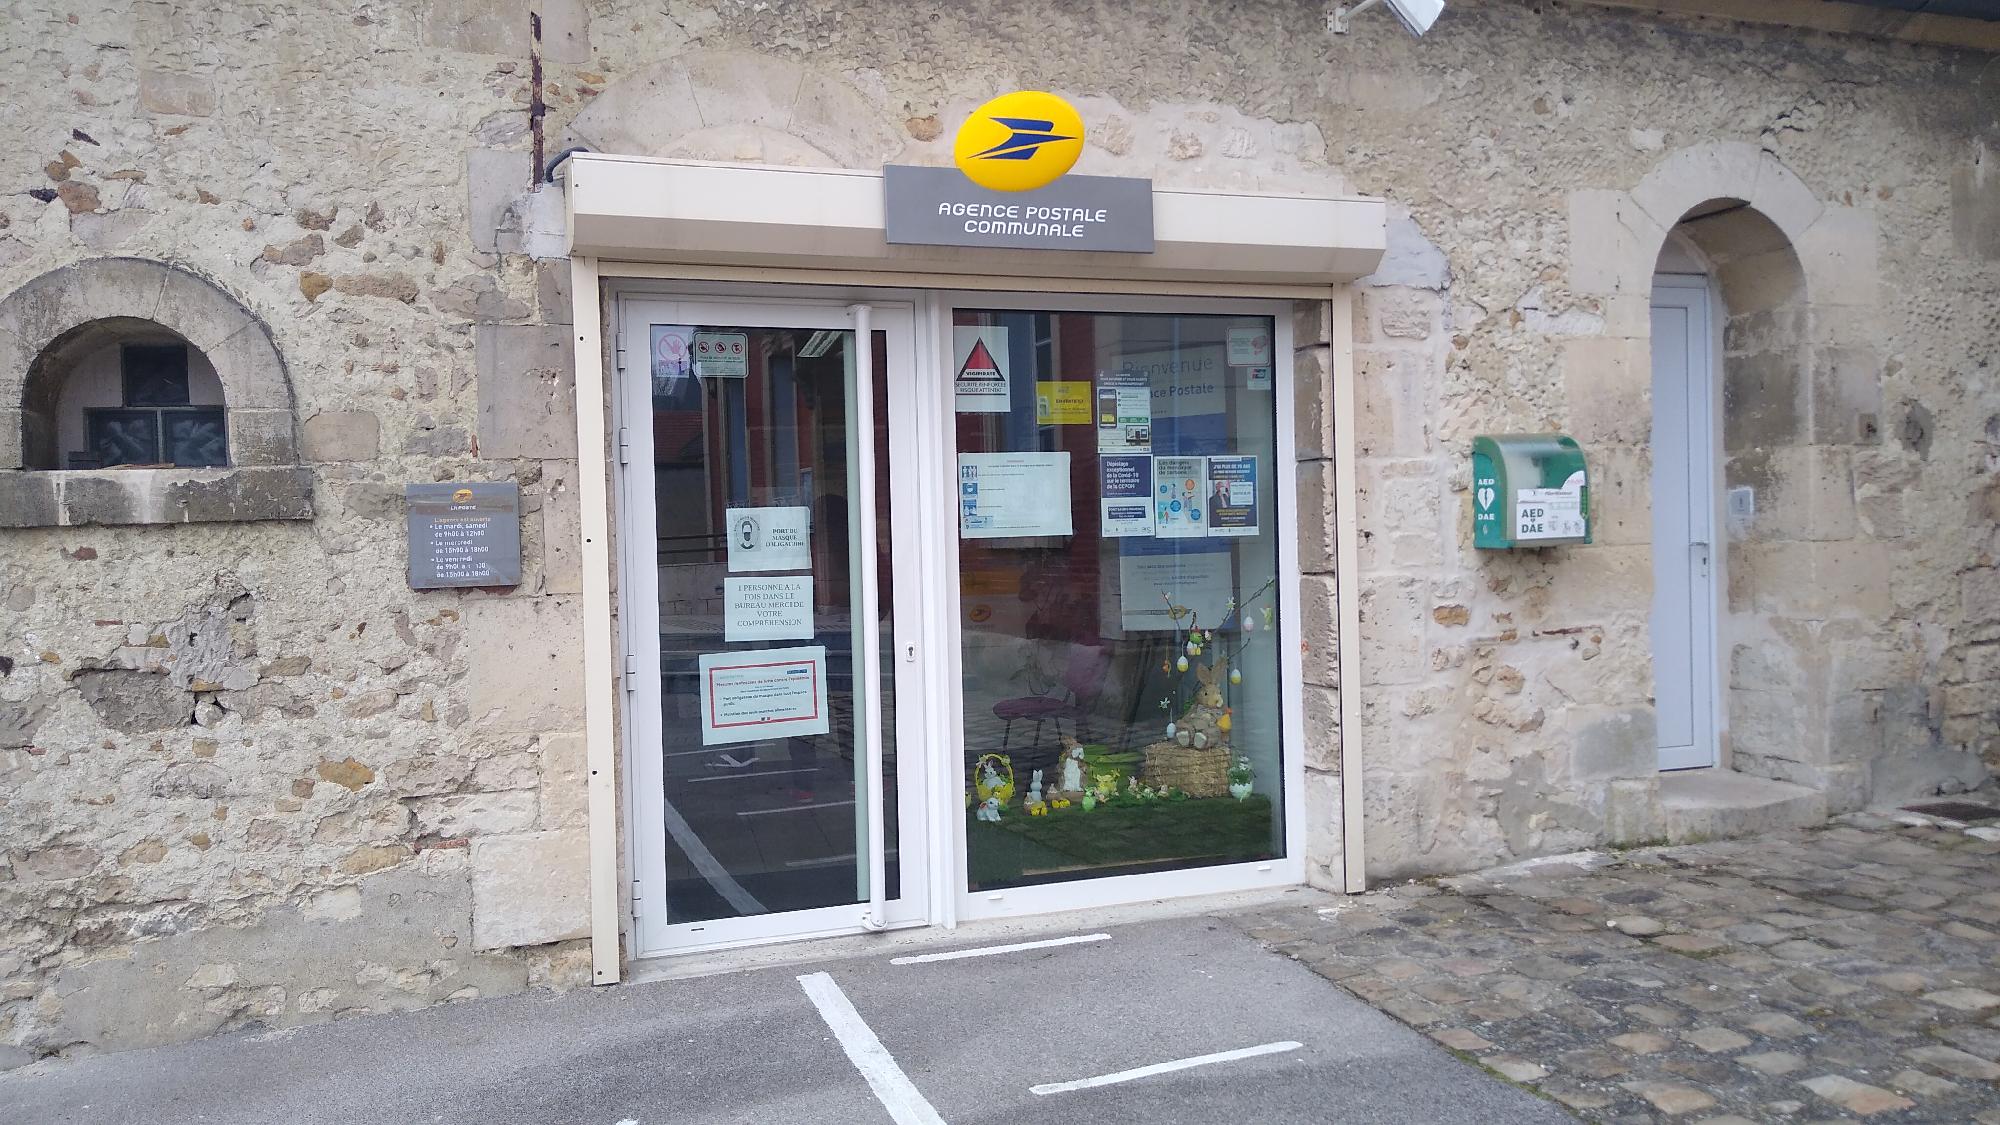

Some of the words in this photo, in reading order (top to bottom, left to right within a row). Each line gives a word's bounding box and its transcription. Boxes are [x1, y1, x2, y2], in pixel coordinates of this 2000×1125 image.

[938, 202, 1020, 219] AGENCE
[1025, 206, 1107, 223] POSTALE
[964, 220, 1085, 238] COMMUNALE
[1169, 384, 1214, 397] Postale
[1477, 478, 1495, 486] AED
[1477, 513, 1495, 521] DAE
[1521, 508, 1544, 519] AED
[1521, 523, 1543, 534] DAE
[743, 584, 783, 592] PERSONNE
[791, 583, 801, 591] LA
[744, 593, 761, 601] FOIS
[762, 592, 784, 600] DANS
[785, 592, 795, 600] LE
[768, 601, 793, 609] MERCI
[757, 610, 783, 618] VOTRE
